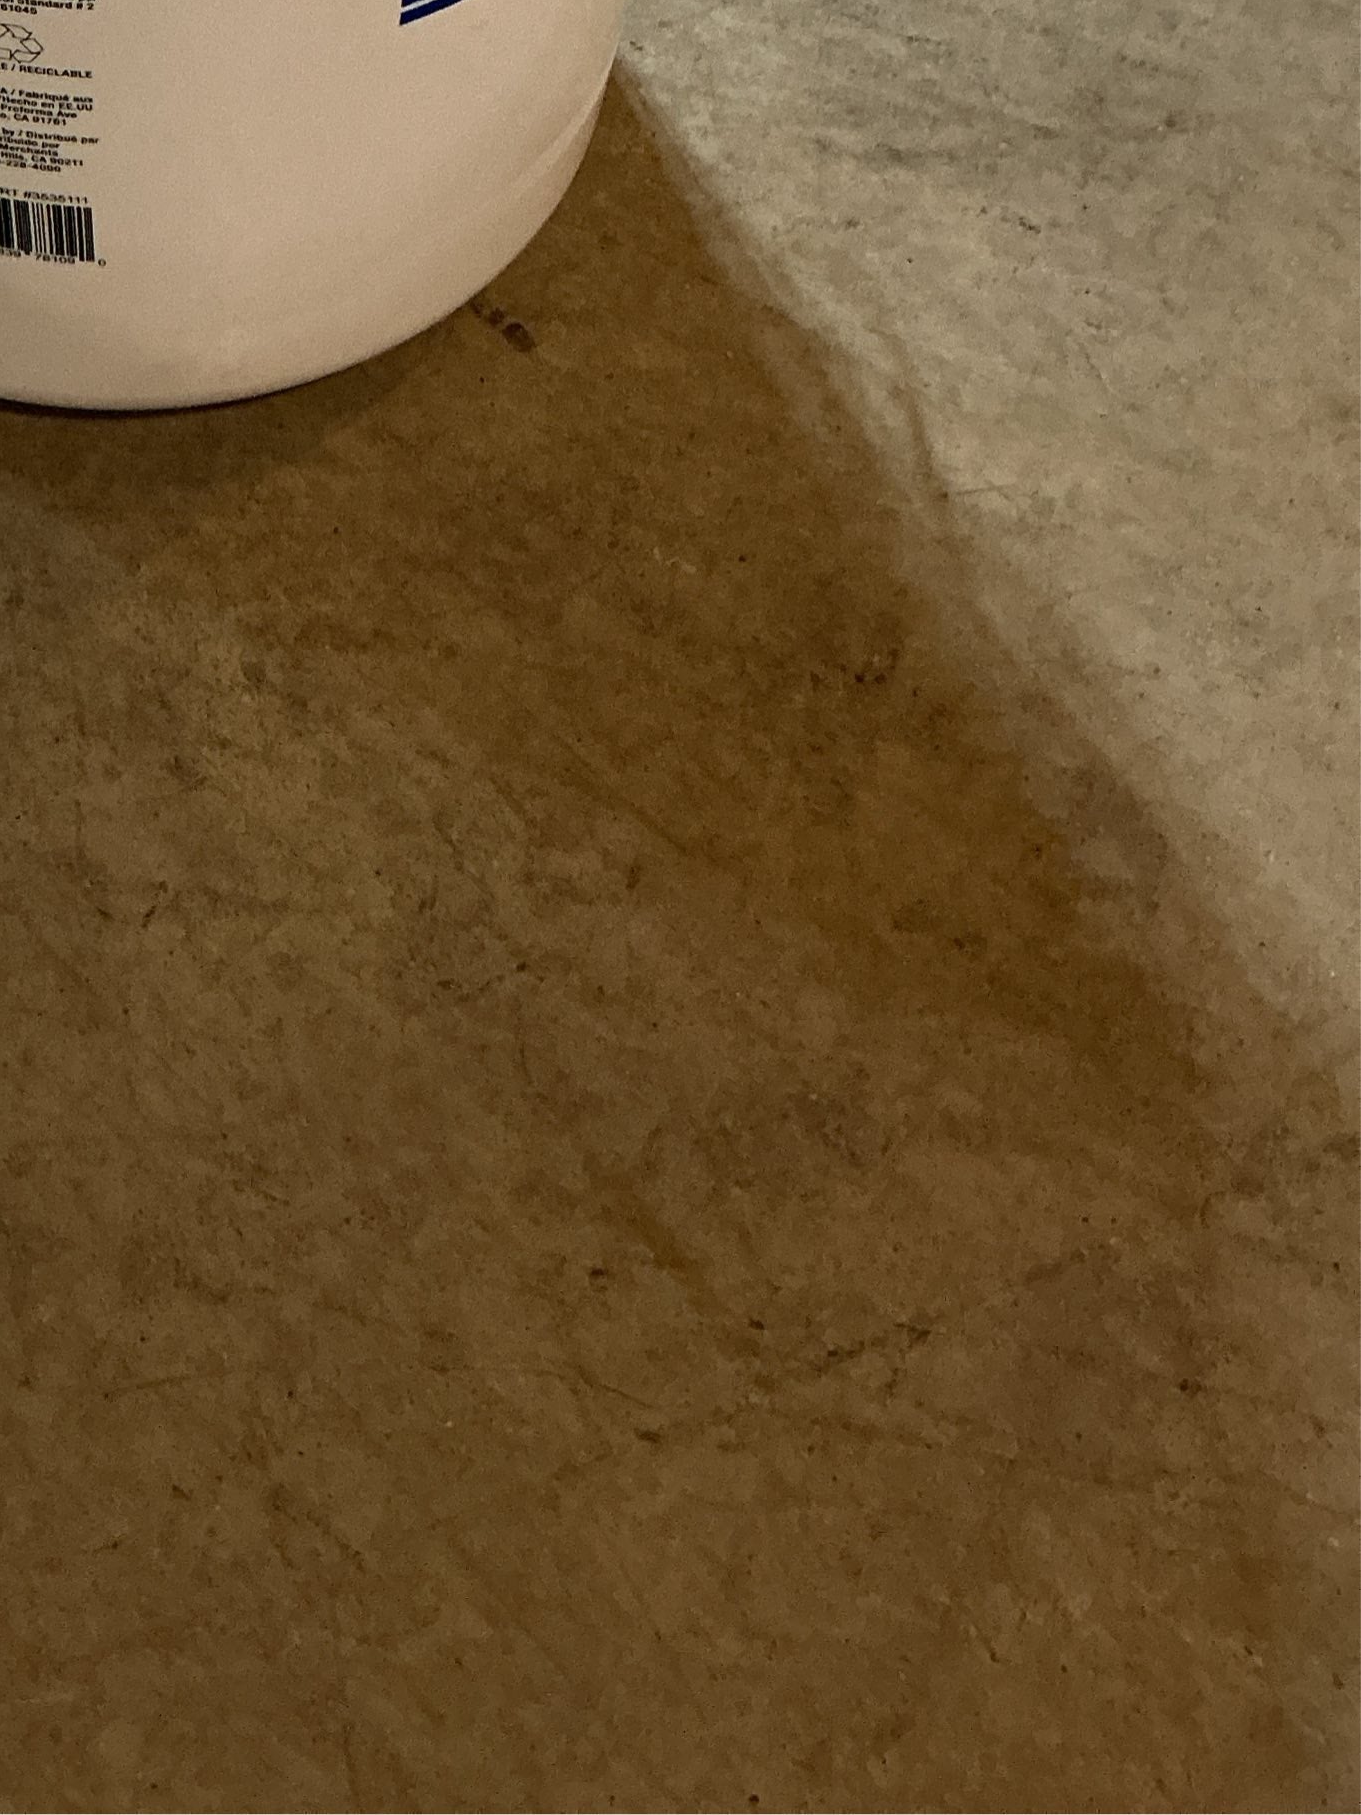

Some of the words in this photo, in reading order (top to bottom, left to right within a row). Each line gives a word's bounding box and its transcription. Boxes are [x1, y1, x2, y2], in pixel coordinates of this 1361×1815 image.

[20, 65, 92, 78] RECICLABLE
[19, 90, 69, 103] Fabriqué
[41, 100, 55, 109] en
[14, 114, 29, 123] CA
[57, 110, 77, 118] Ave
[2, 127, 15, 137] by
[27, 131, 78, 142] Distribué
[0, 143, 59, 156] Merchants
[32, 155, 47, 164] CA
